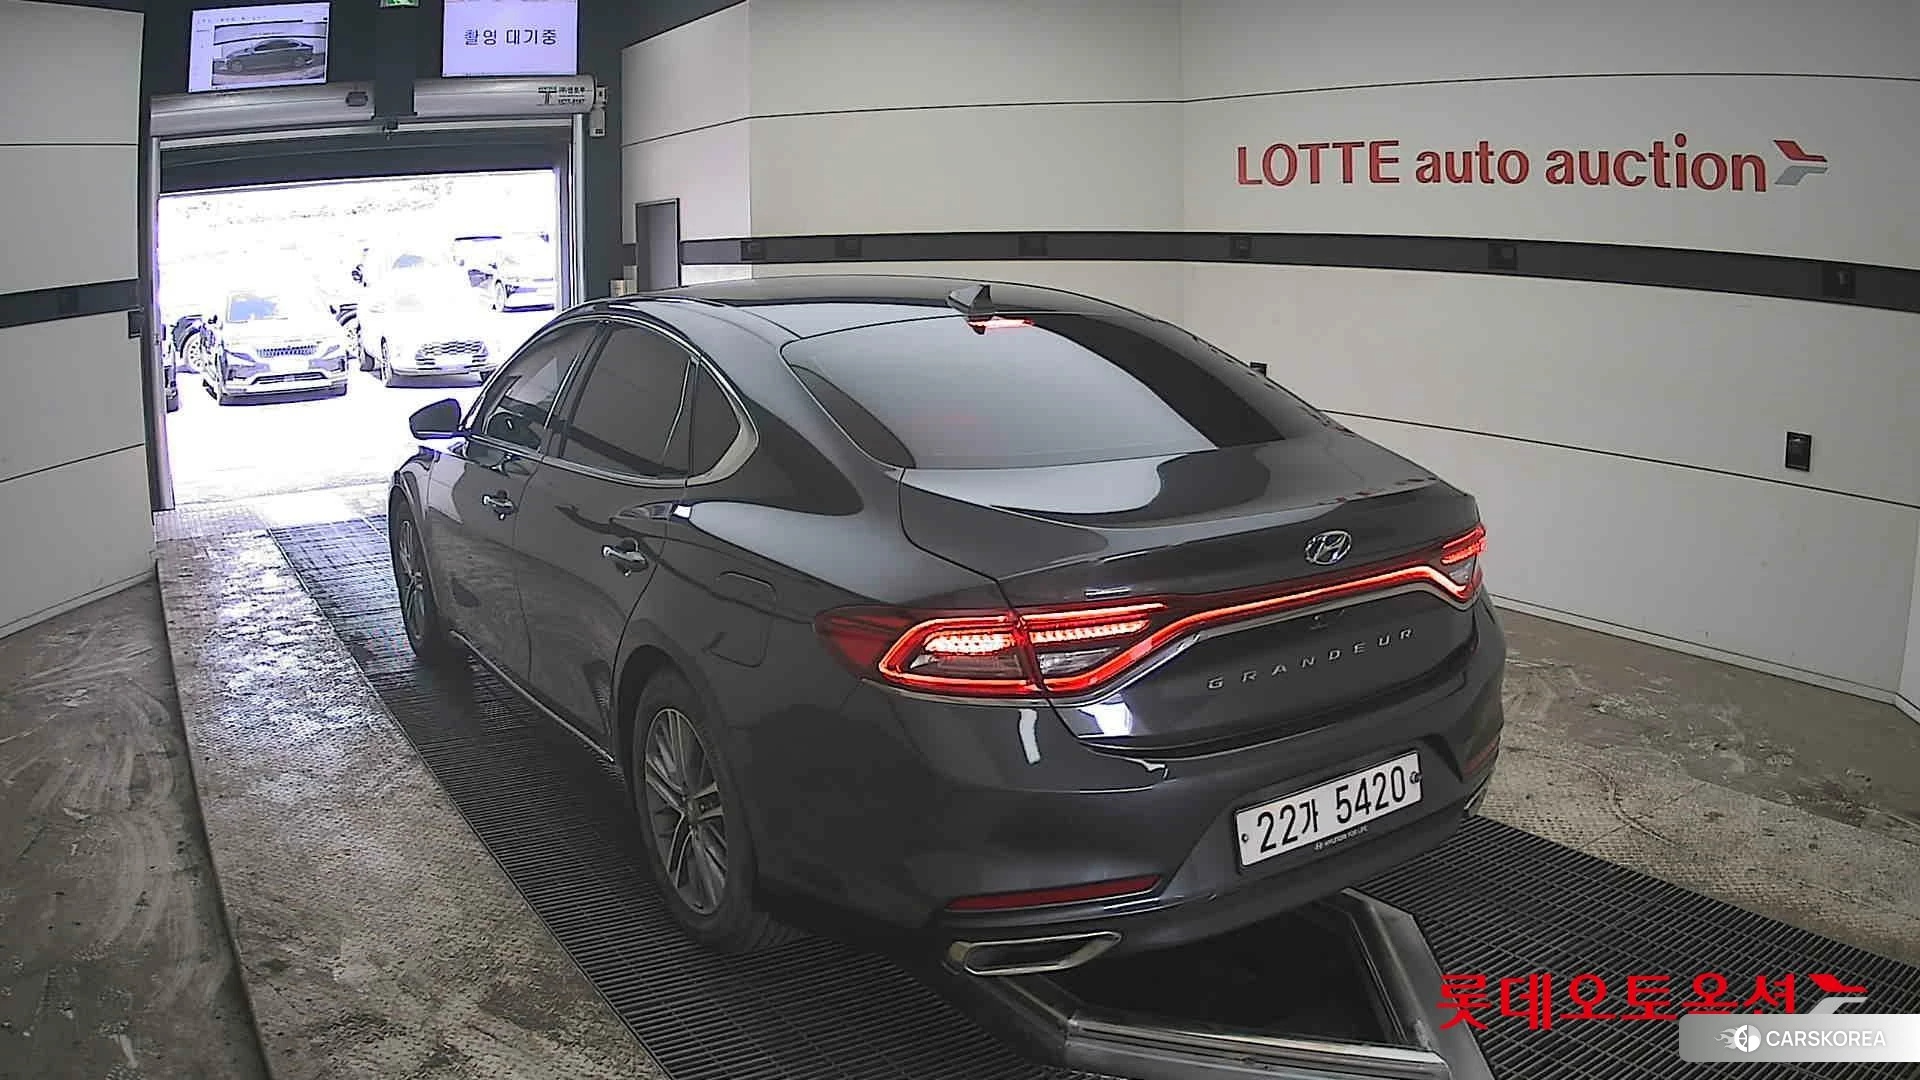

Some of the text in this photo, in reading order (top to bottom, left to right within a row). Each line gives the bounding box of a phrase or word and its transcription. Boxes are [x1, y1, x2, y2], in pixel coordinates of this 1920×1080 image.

[506, 29, 557, 46] 대기중
[1238, 132, 1767, 192] LOTTE auto auction
[1207, 629, 1415, 690] GRANDEUR
[1257, 798, 1319, 853] 22가
[1335, 765, 1407, 825] 5420
